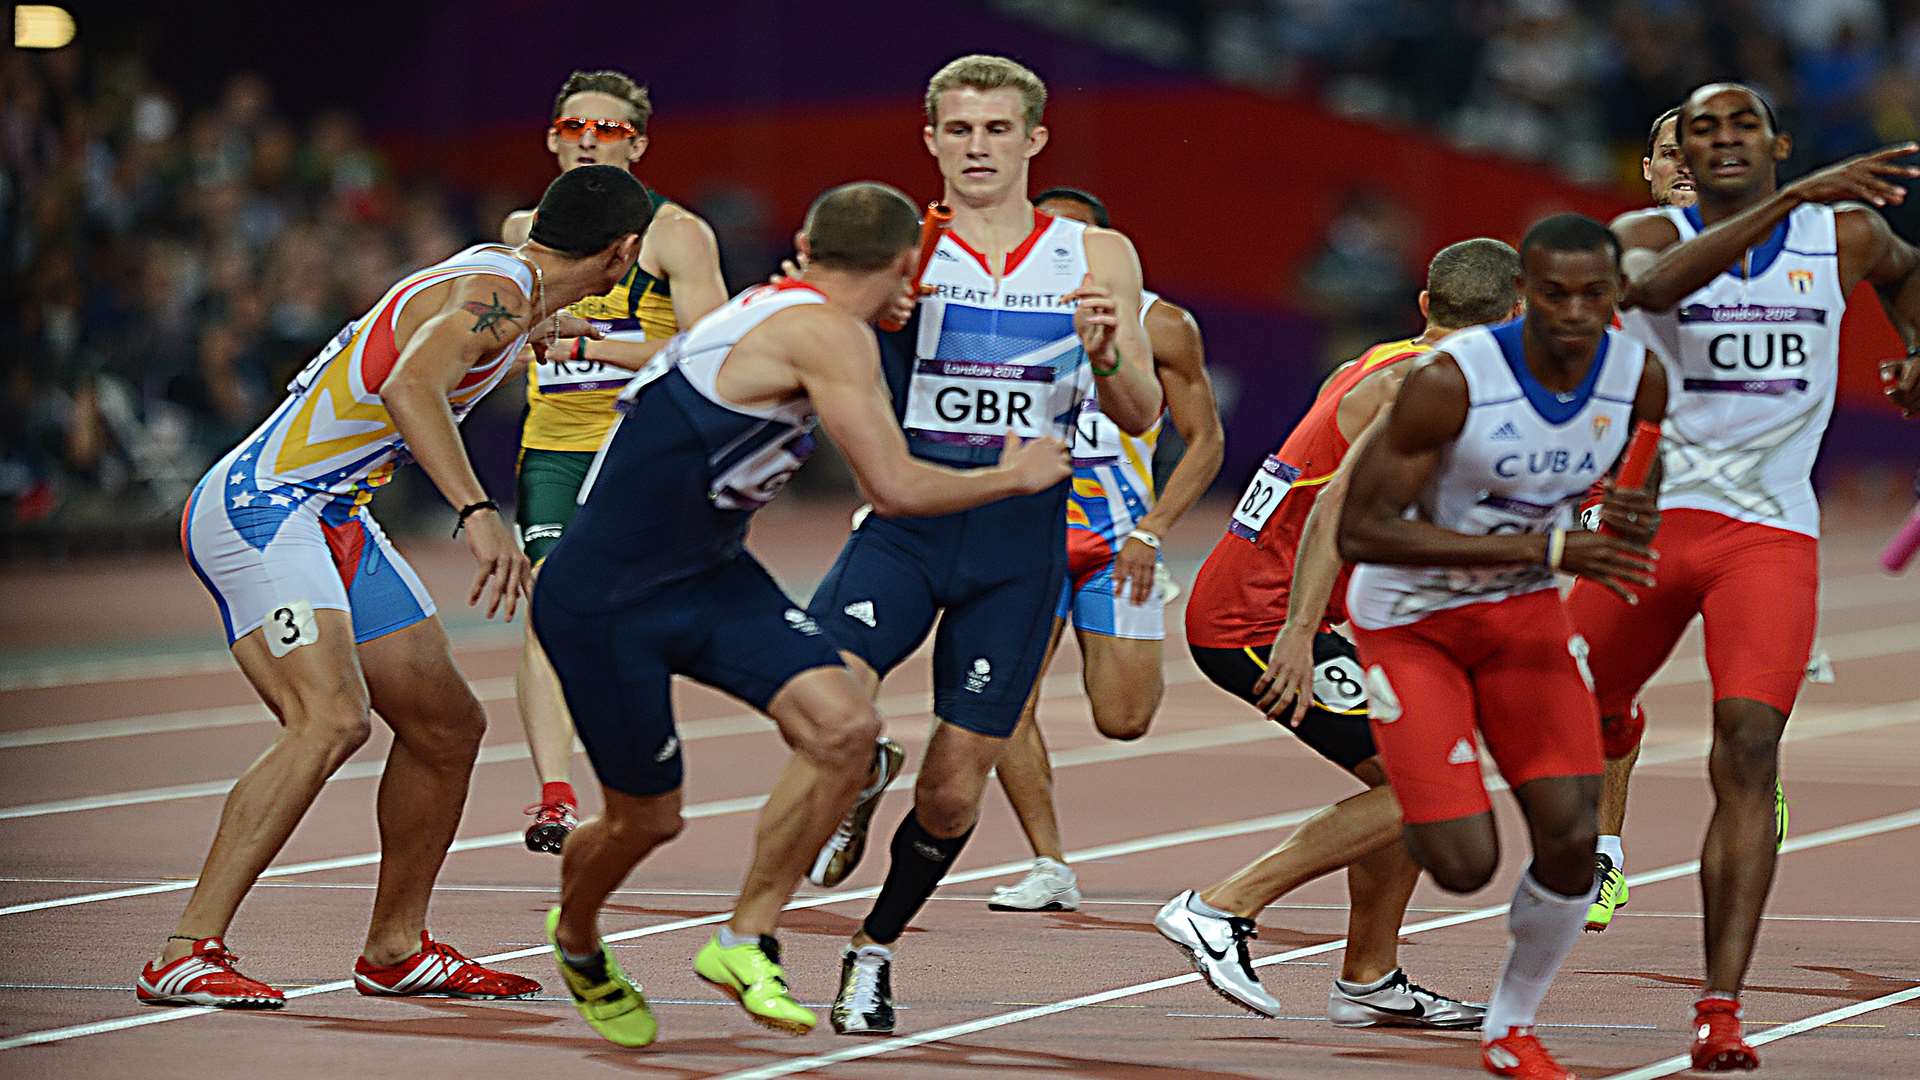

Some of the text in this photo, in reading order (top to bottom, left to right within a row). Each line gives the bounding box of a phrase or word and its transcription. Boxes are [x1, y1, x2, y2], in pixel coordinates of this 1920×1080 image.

[1764, 307, 1798, 321] 2012
[1708, 333, 1806, 370] CUB
[944, 361, 1026, 380] London 2012
[935, 386, 1032, 427] GBR
[1495, 450, 1597, 478] CUBA
[274, 607, 300, 645] 3
[1324, 665, 1362, 699] 8
